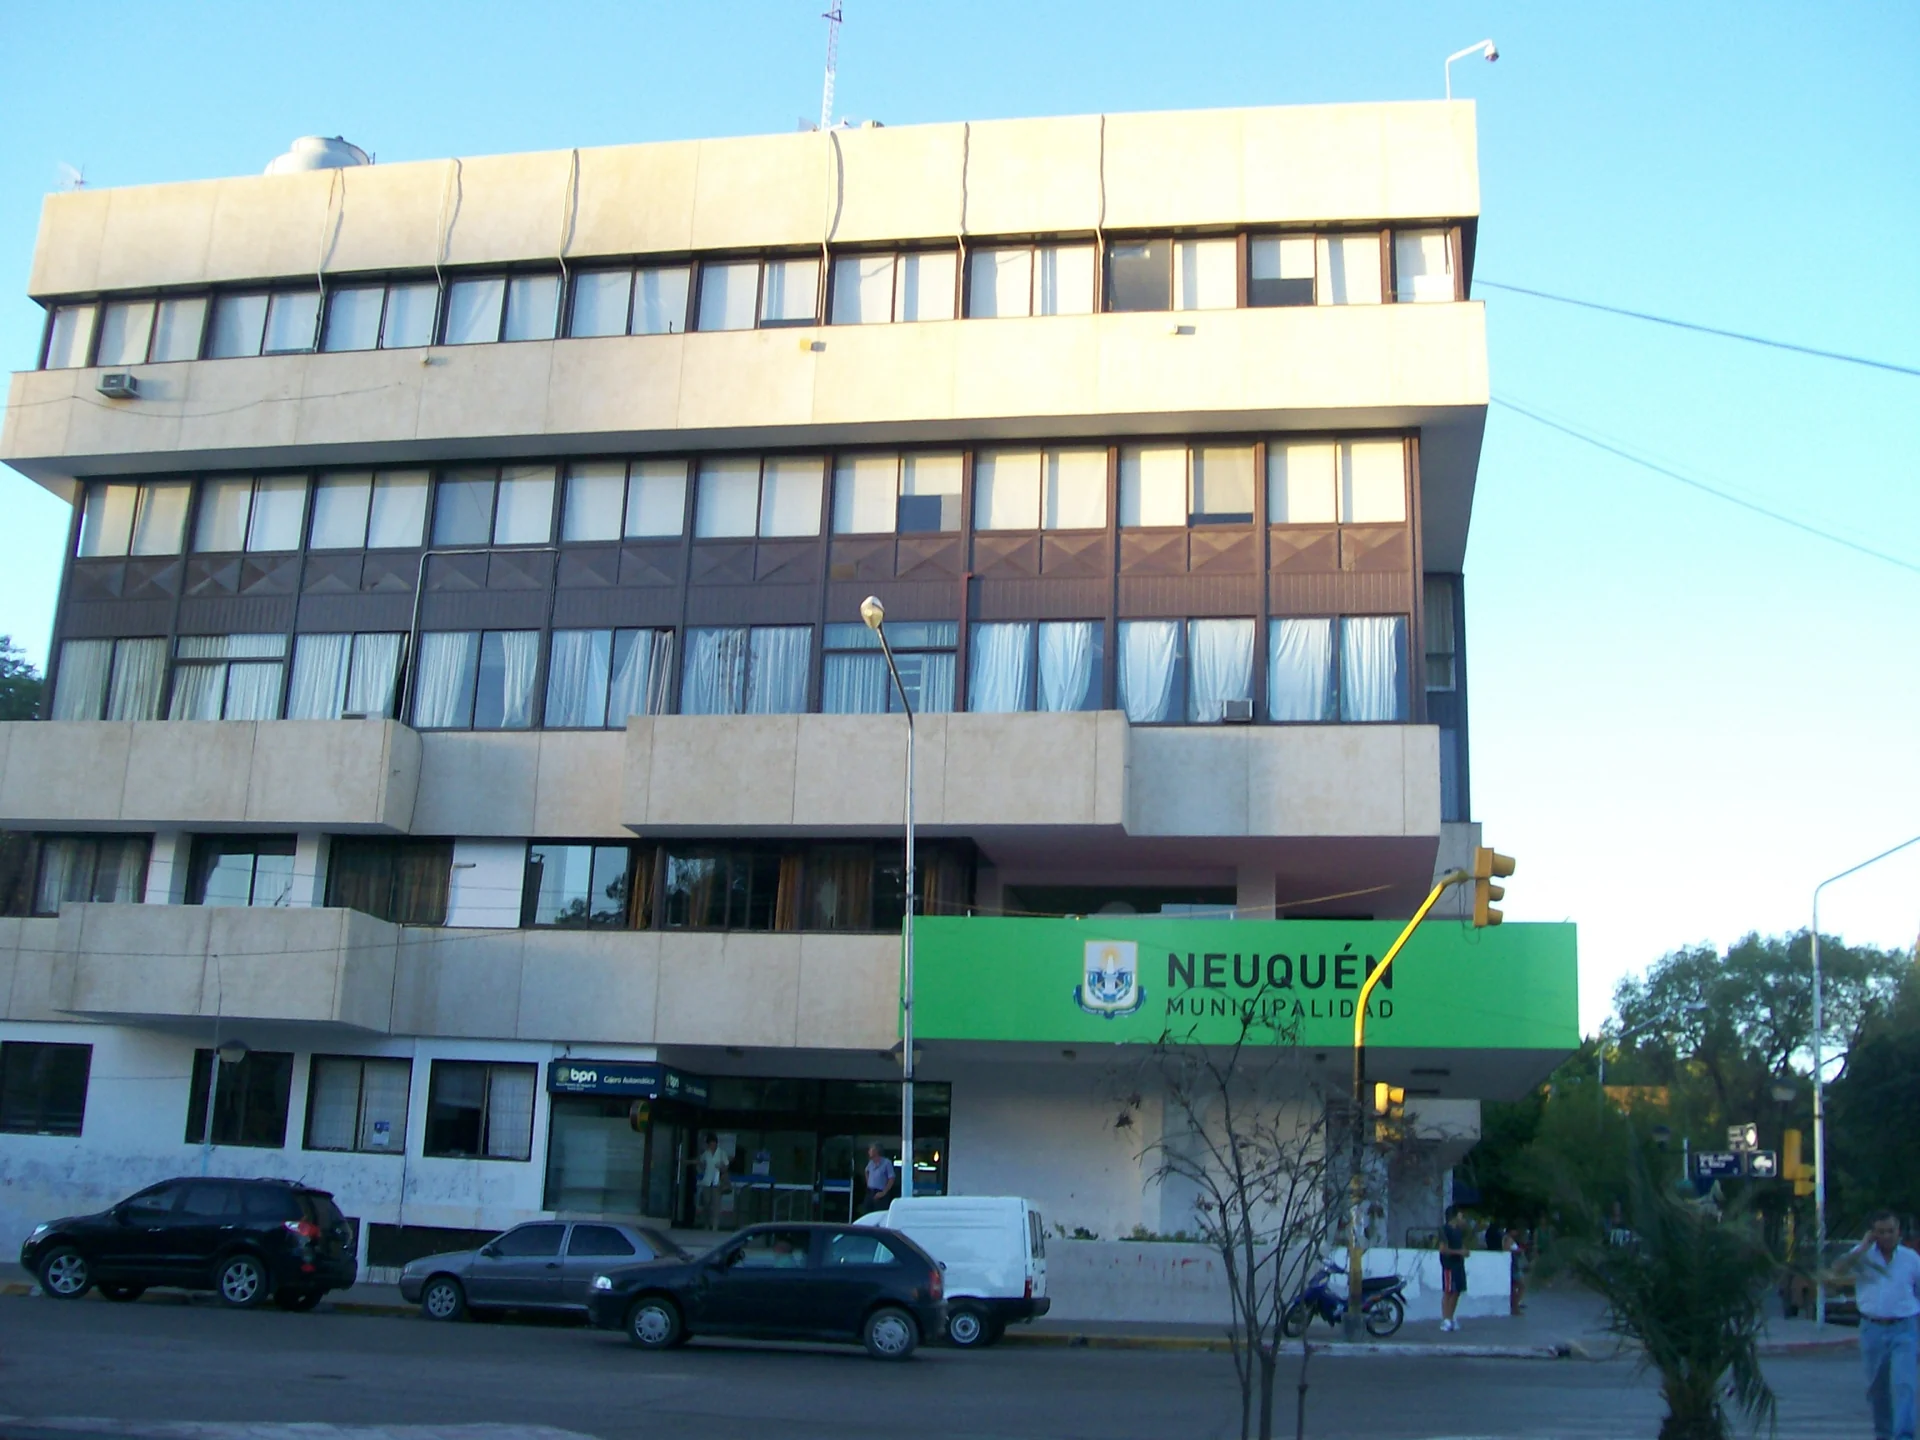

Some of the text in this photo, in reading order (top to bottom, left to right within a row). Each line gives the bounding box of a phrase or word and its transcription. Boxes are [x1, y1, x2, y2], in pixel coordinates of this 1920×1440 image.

[1168, 943, 1393, 989] NEUQUÉN
[1167, 998, 1393, 1018] MUNICIPALIDAD
[570, 1068, 597, 1083] bpn
